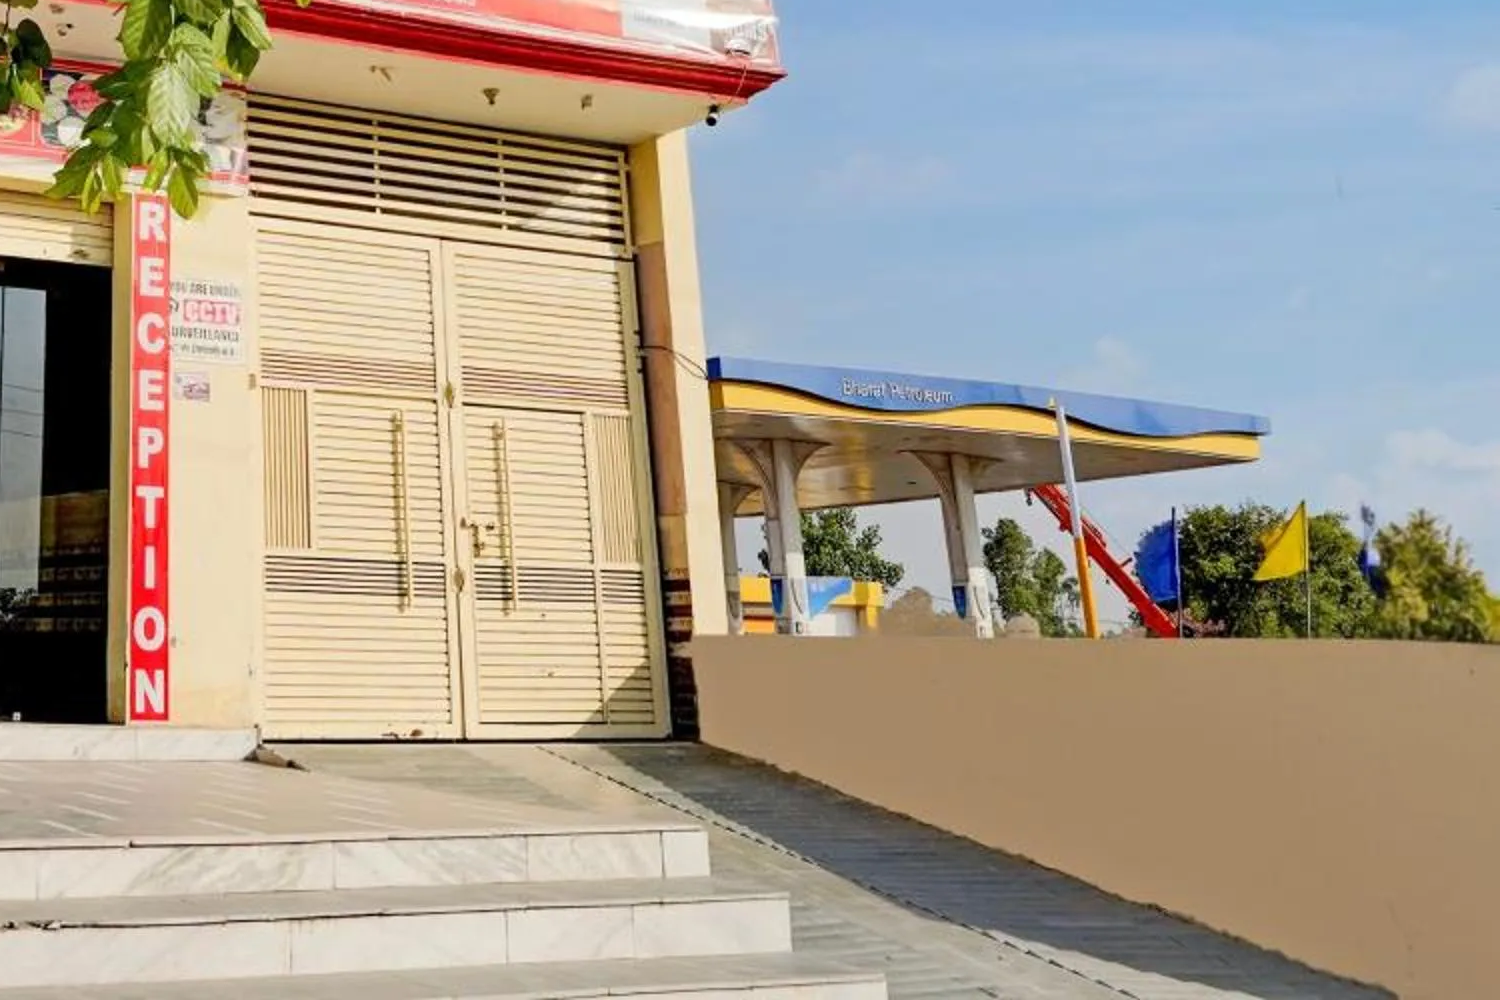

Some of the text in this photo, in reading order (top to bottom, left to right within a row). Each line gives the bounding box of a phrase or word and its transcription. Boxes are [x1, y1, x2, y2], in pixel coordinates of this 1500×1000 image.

[184, 300, 240, 325] CCTV
[843, 378, 886, 397] Bharat
[133, 200, 167, 714] RECEPTION
